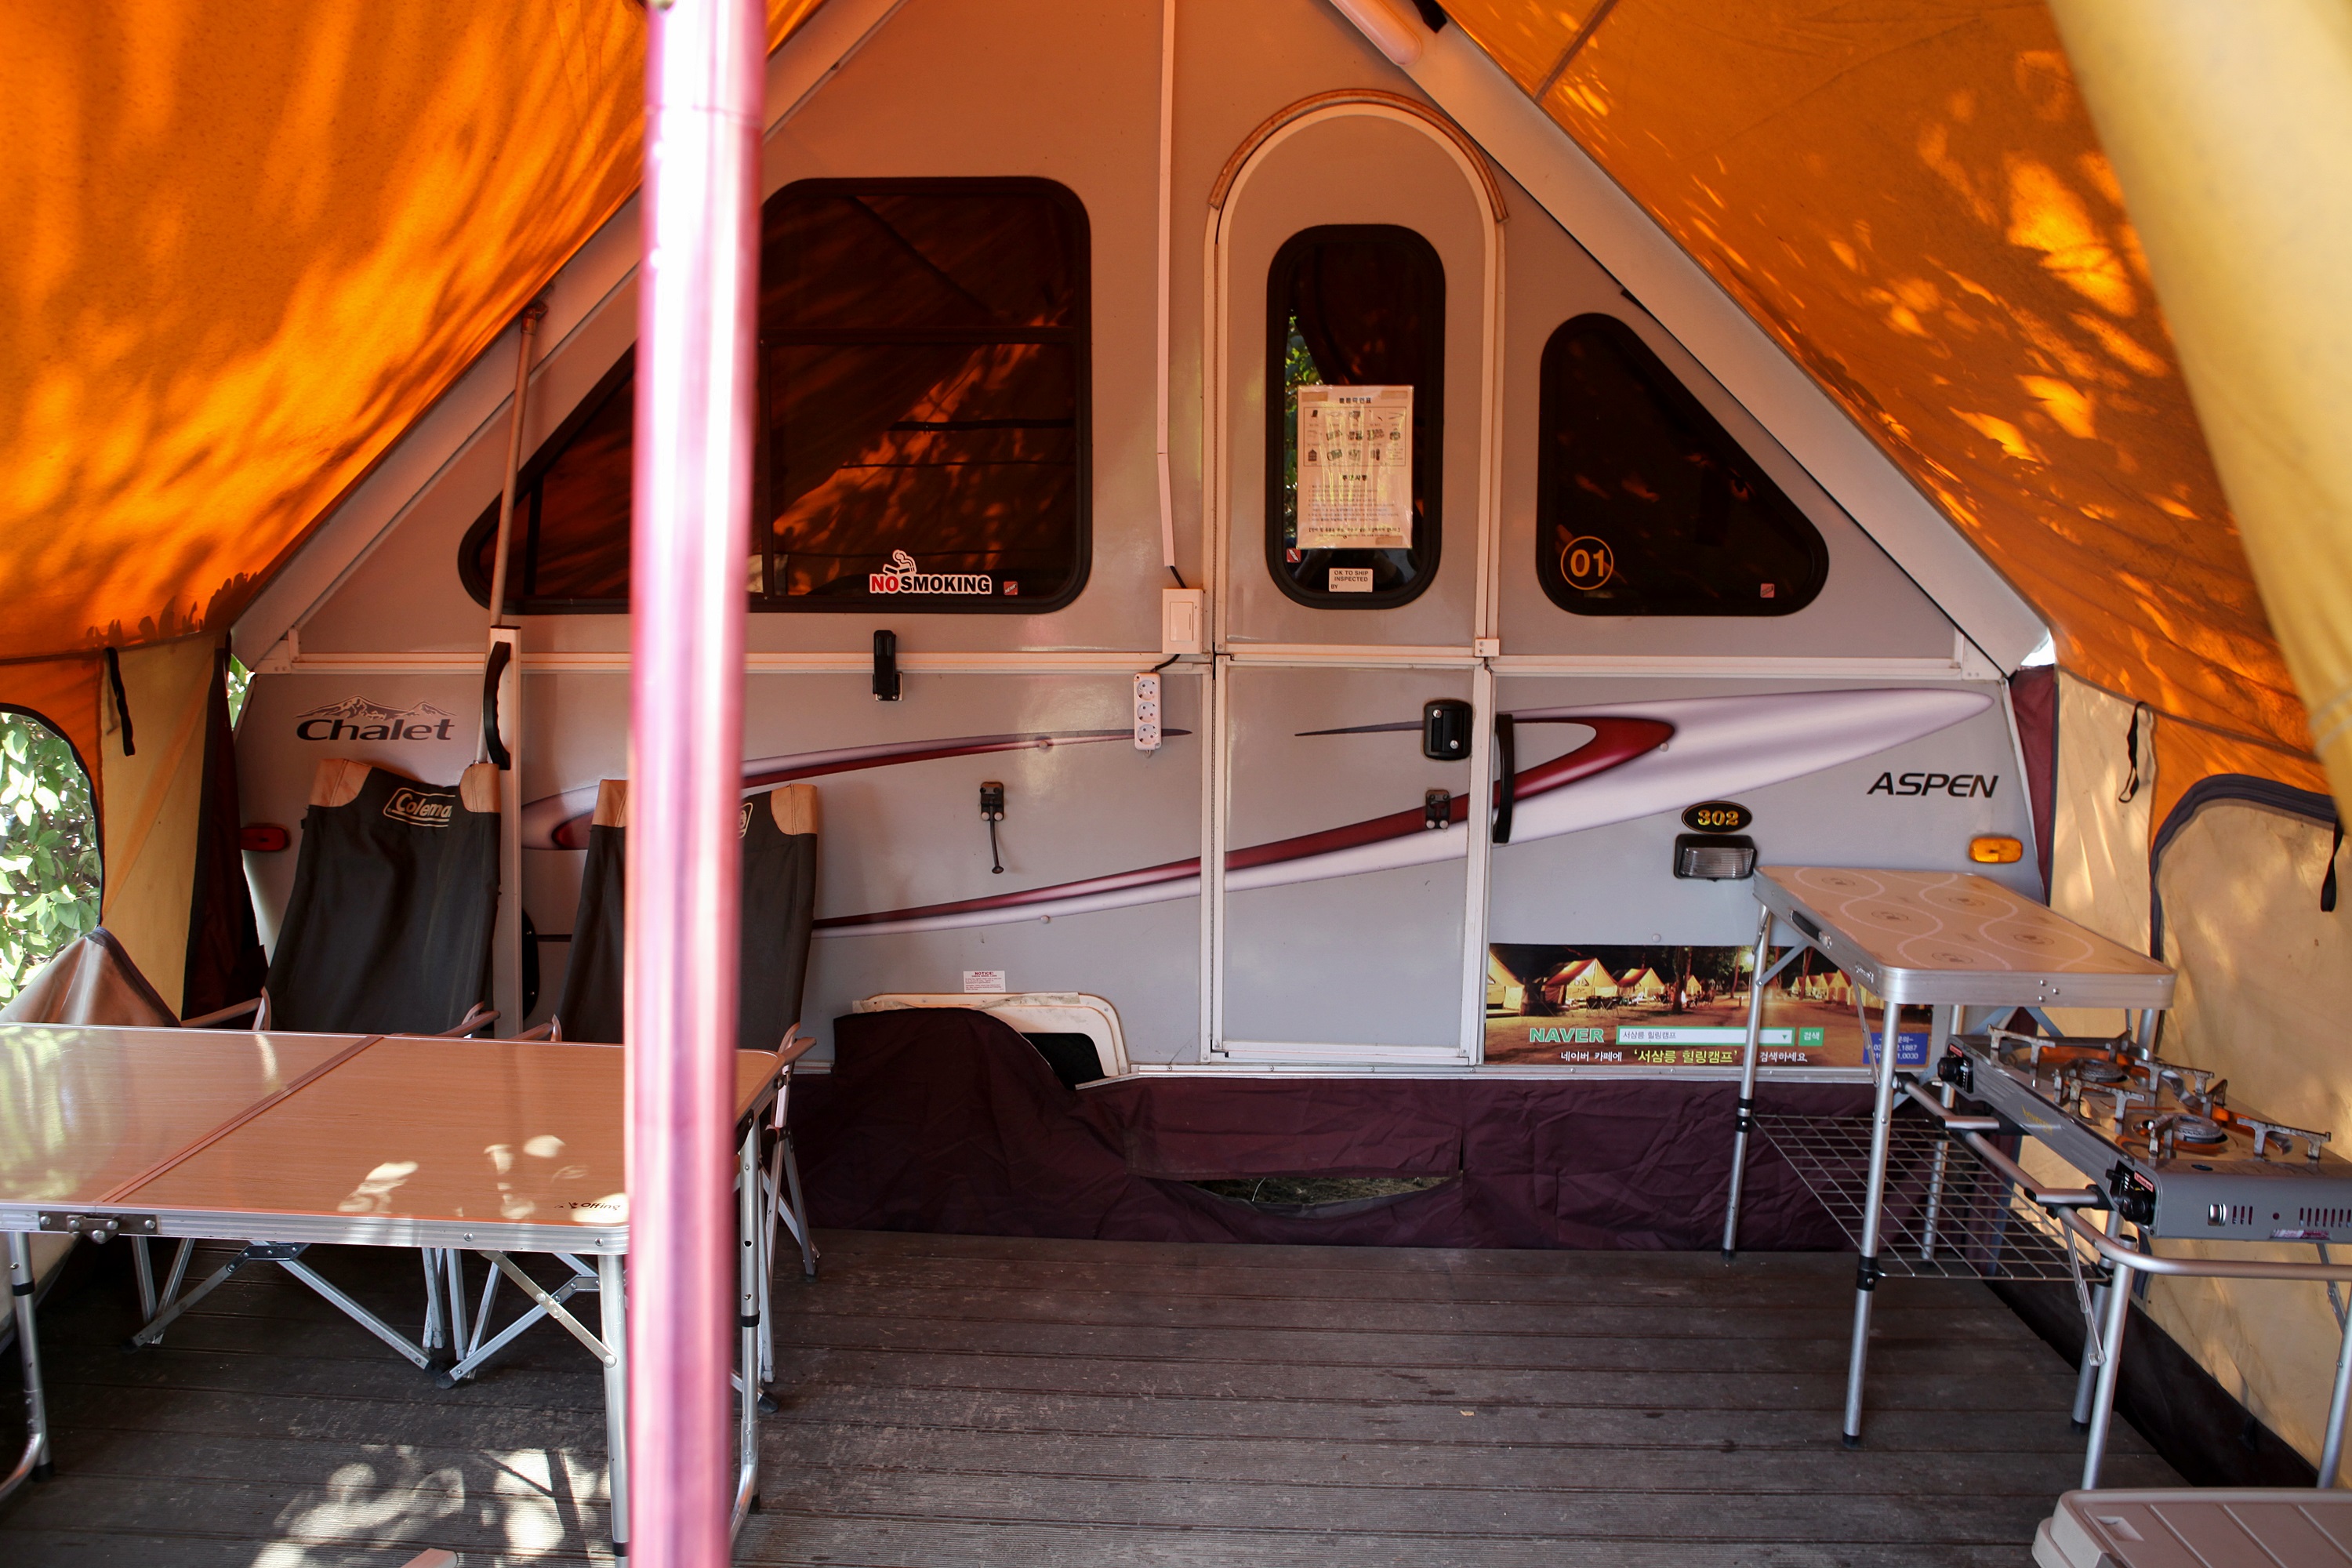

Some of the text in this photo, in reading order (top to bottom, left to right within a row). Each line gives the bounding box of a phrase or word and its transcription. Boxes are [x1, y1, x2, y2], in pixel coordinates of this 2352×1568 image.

[1570, 549, 1604, 577] 01
[871, 575, 991, 593] NO SMOKING
[296, 719, 455, 741] Chalet
[1867, 772, 1999, 798] ASPEN
[396, 793, 452, 818] Colema
[1697, 809, 1739, 826] 302
[1530, 1027, 1604, 1044] NAVER
[1623, 1031, 1820, 1040] 서삼릉 힐링캠프 검색
[1561, 1051, 1589, 1062] 네이버
[1595, 1051, 1622, 1062] 카페에
